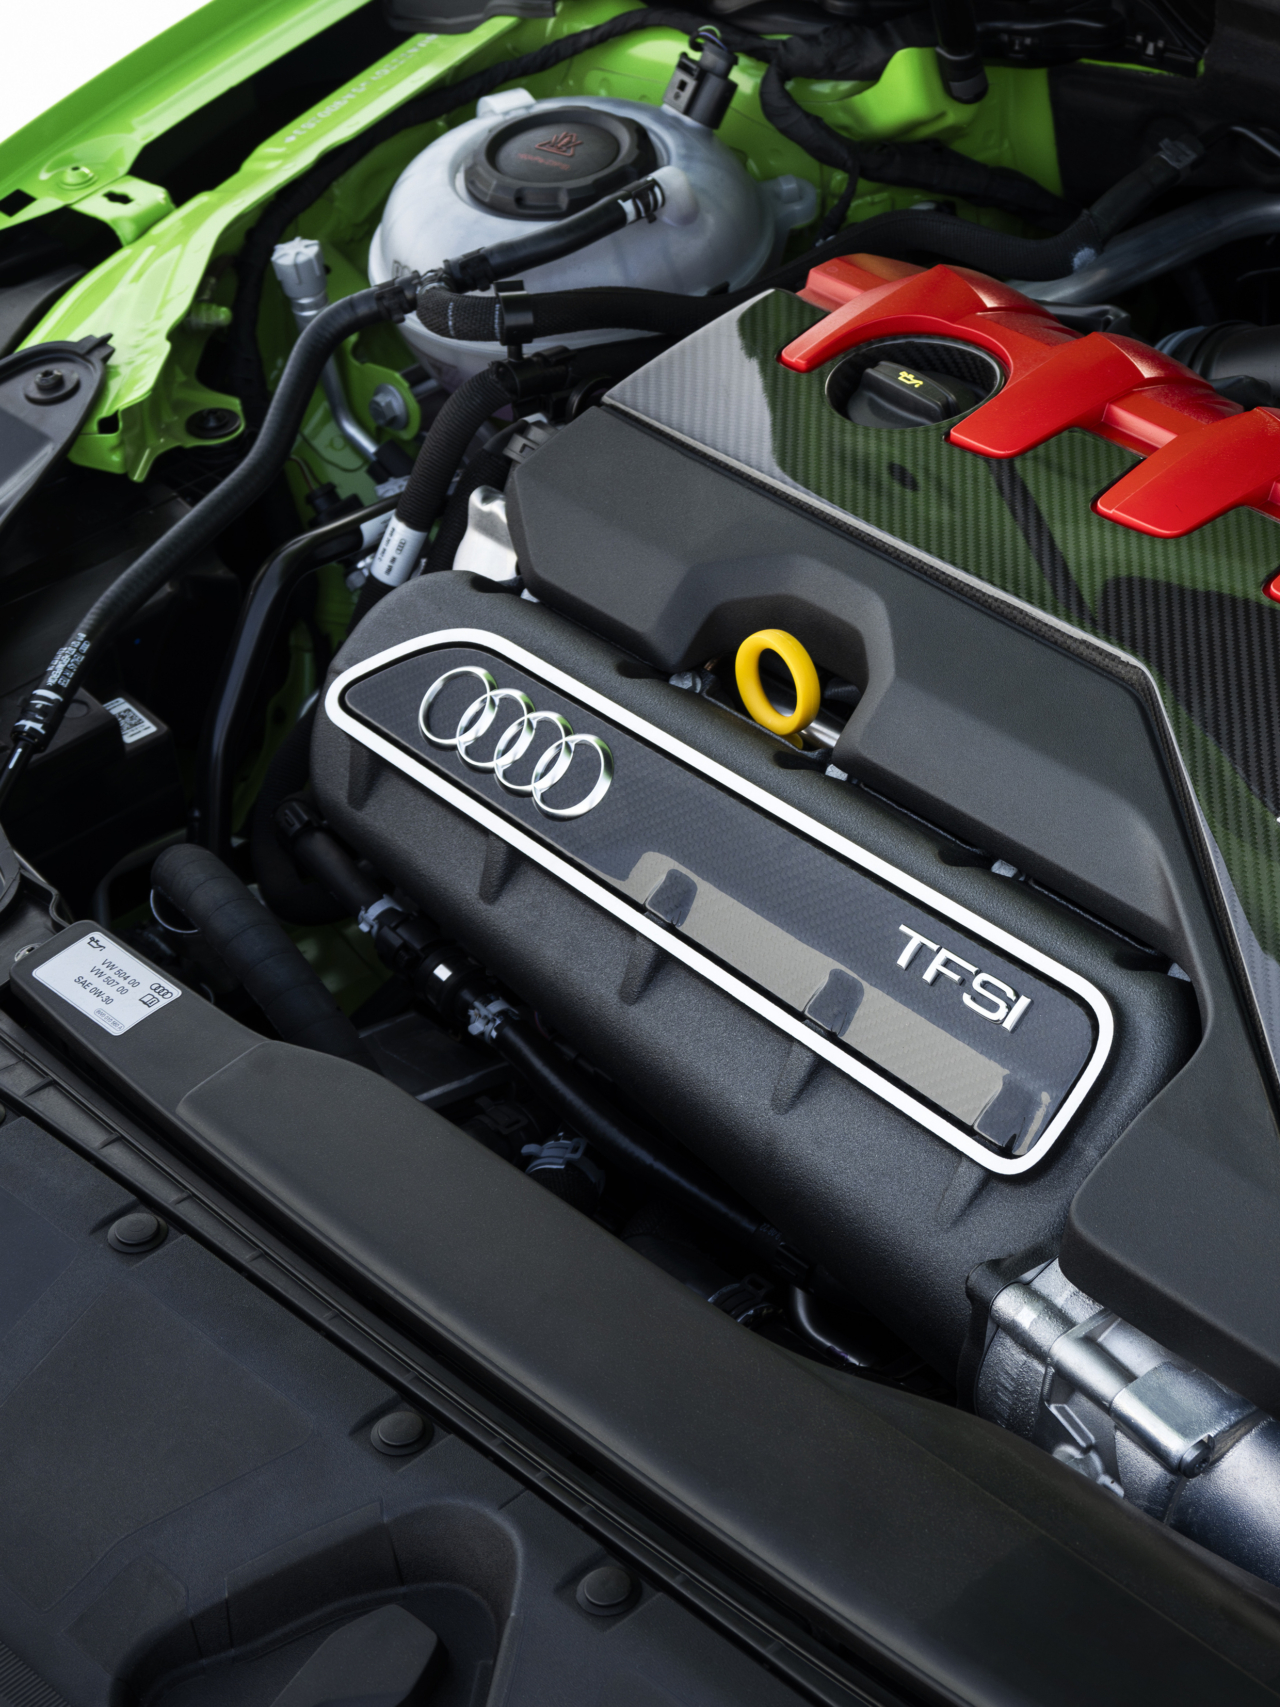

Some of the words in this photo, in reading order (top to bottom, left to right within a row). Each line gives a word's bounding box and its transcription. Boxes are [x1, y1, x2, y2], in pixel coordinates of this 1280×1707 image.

[89, 965, 107, 979] VW
[102, 975, 120, 988] 507
[116, 985, 129, 995] 00
[101, 958, 118, 971] VW
[114, 968, 131, 981] 504
[127, 978, 141, 988] 00
[896, 923, 1032, 1033] TFSI
[73, 975, 93, 990] SAE
[88, 986, 114, 1005] 0W-30
